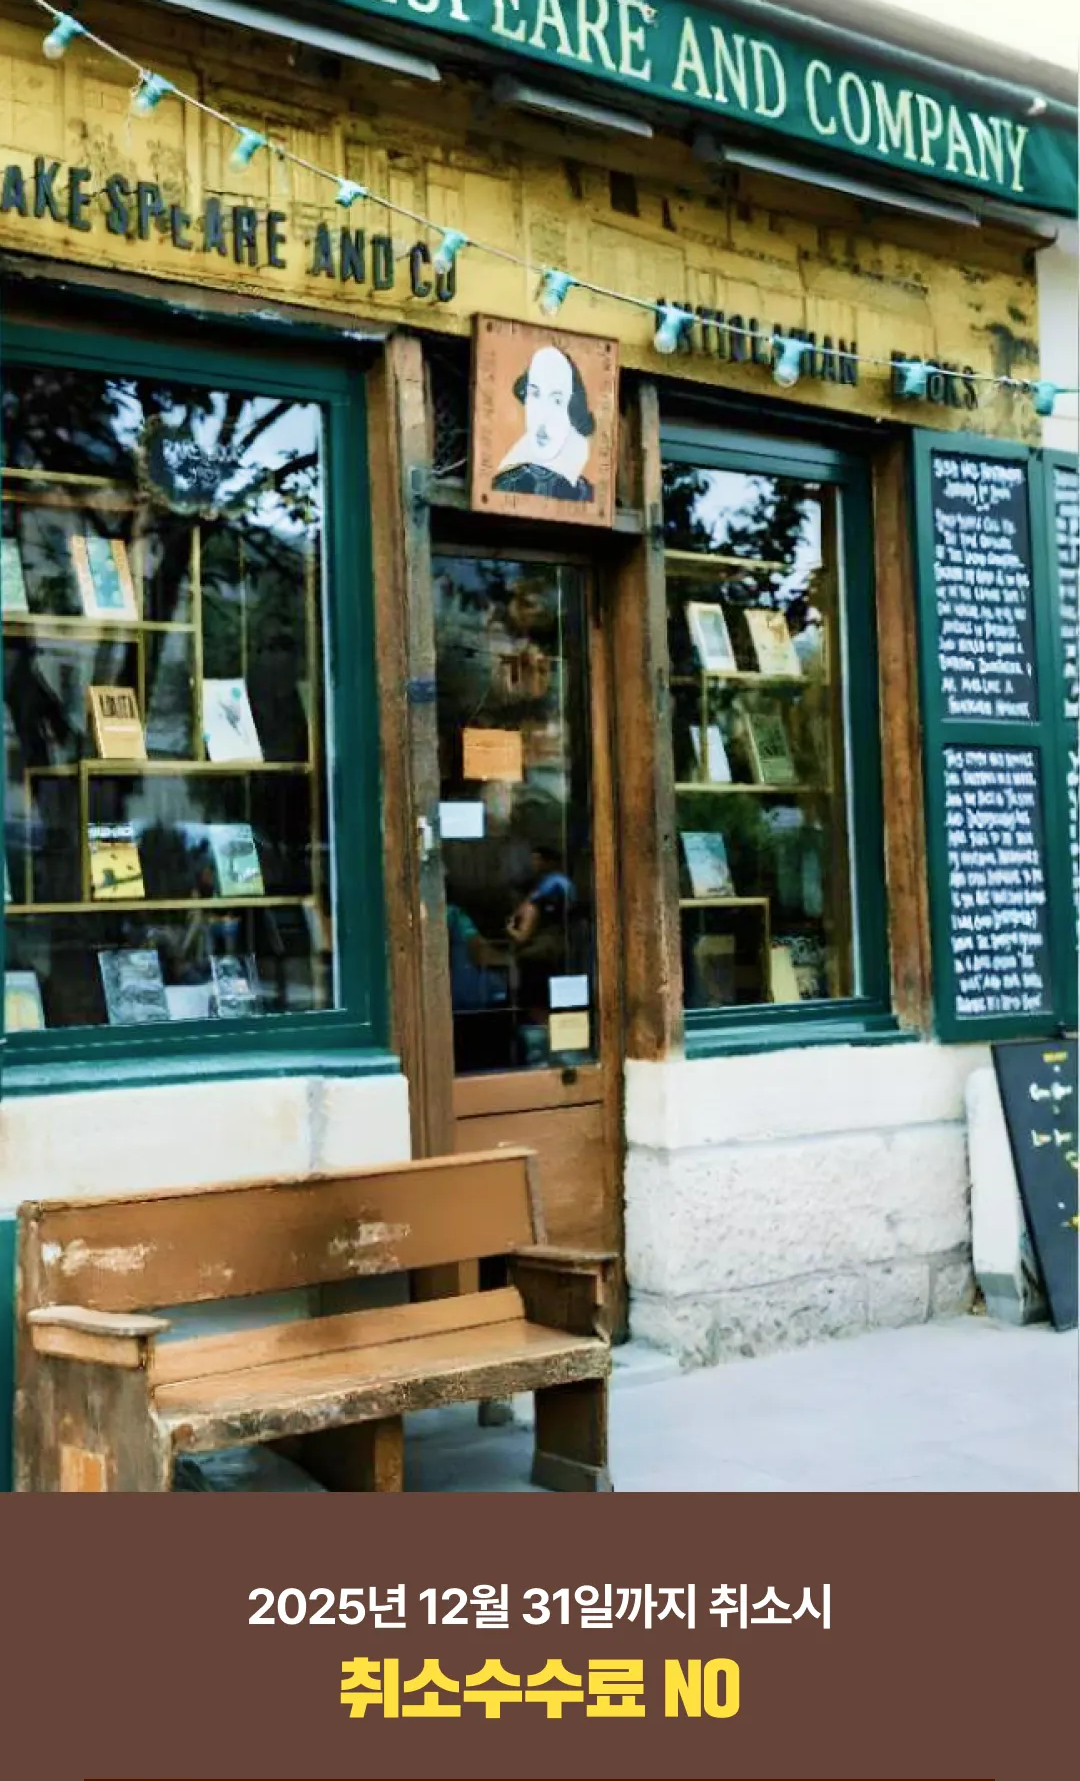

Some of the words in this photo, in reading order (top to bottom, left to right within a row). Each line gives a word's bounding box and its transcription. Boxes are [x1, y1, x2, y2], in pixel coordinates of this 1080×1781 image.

[672, 17, 786, 119] AND
[804, 59, 1029, 192] COMPANY
[312, 222, 394, 291] AND
[891, 351, 979, 411] BOKS
[249, 1584, 406, 1629] 2025년
[419, 1584, 509, 1629] 12월
[522, 1584, 695, 1629] 31일까지
[709, 1584, 830, 1629] 취소시
[340, 1657, 645, 1719] 취소수수료
[665, 1658, 740, 1718] NO
